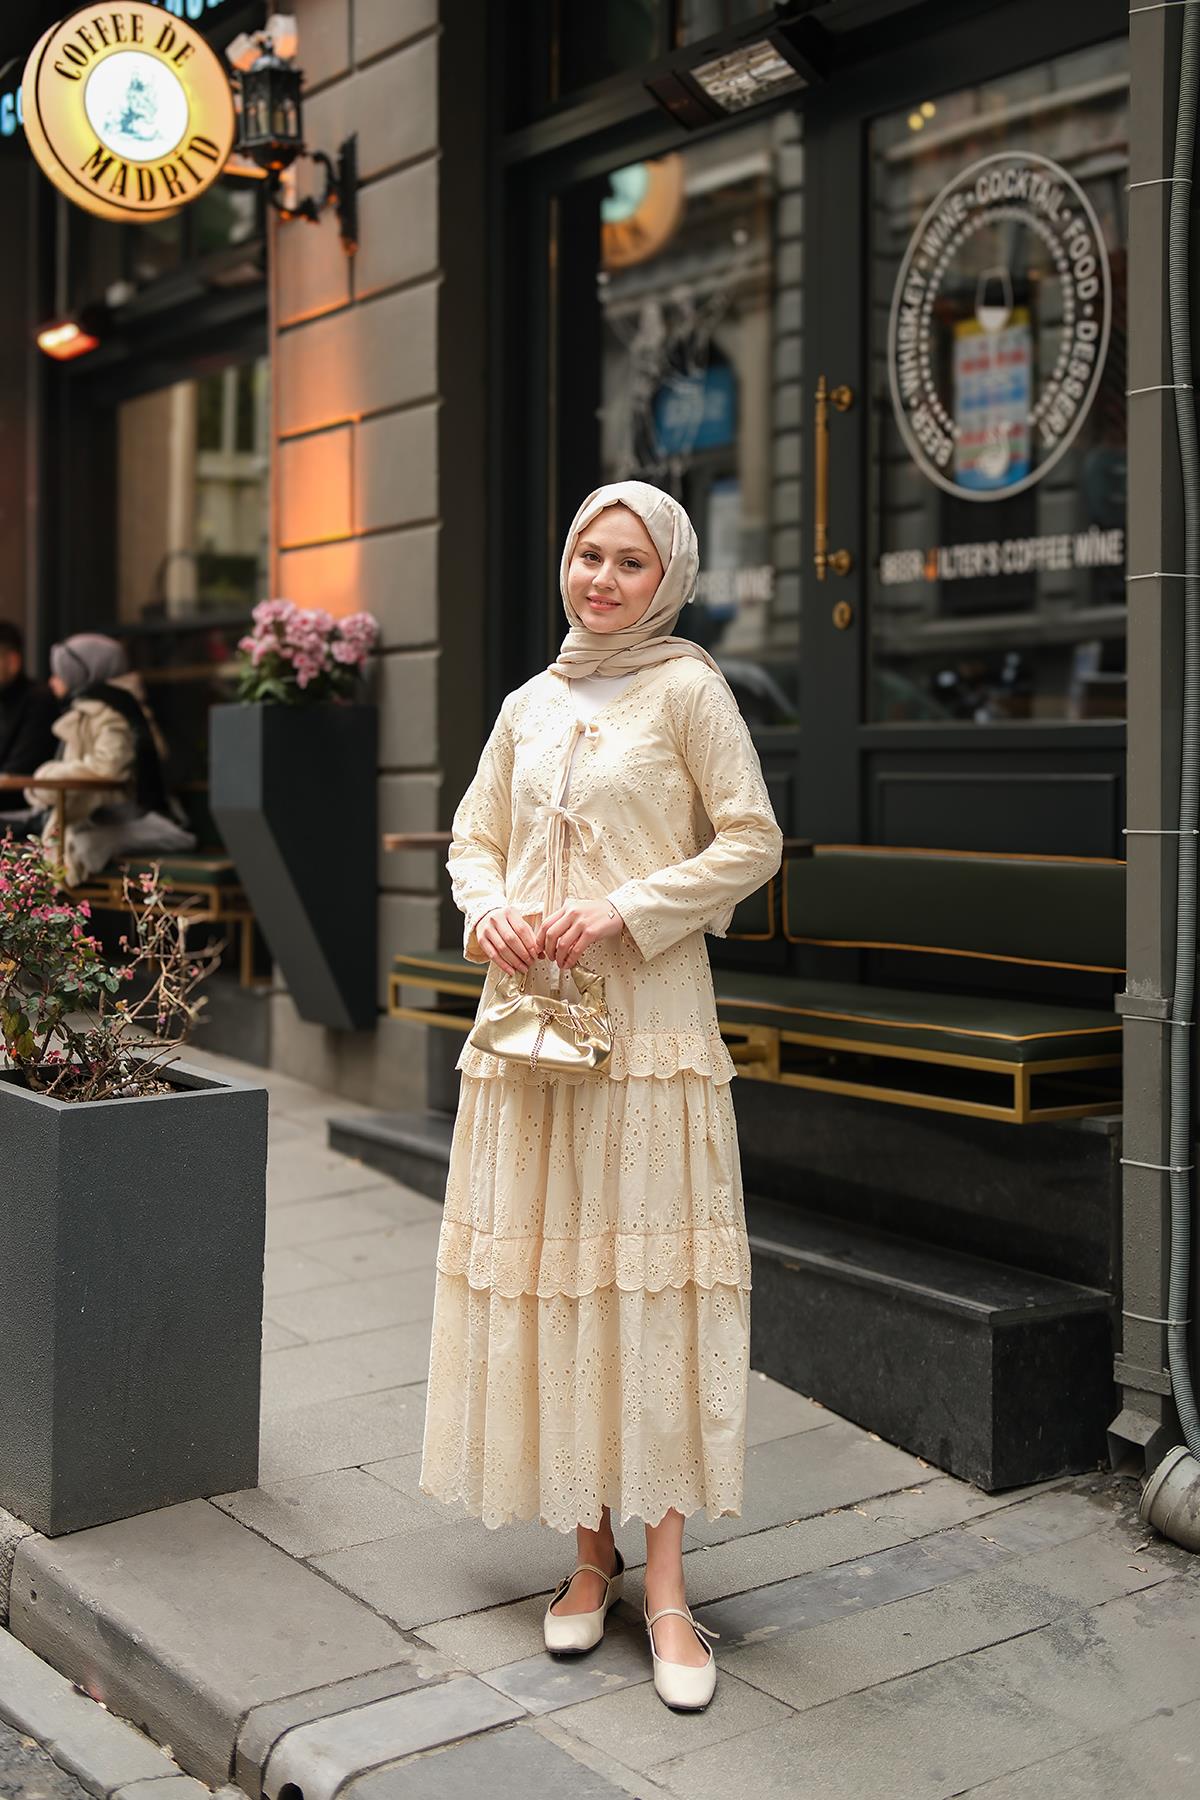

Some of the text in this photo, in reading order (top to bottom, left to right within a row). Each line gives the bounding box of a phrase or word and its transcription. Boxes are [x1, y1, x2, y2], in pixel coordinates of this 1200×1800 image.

[53, 13, 196, 82] COFFEE DE
[897, 168, 1100, 468] BEER WHISKEY WINE COCKTAIL FOOD DESSERT
